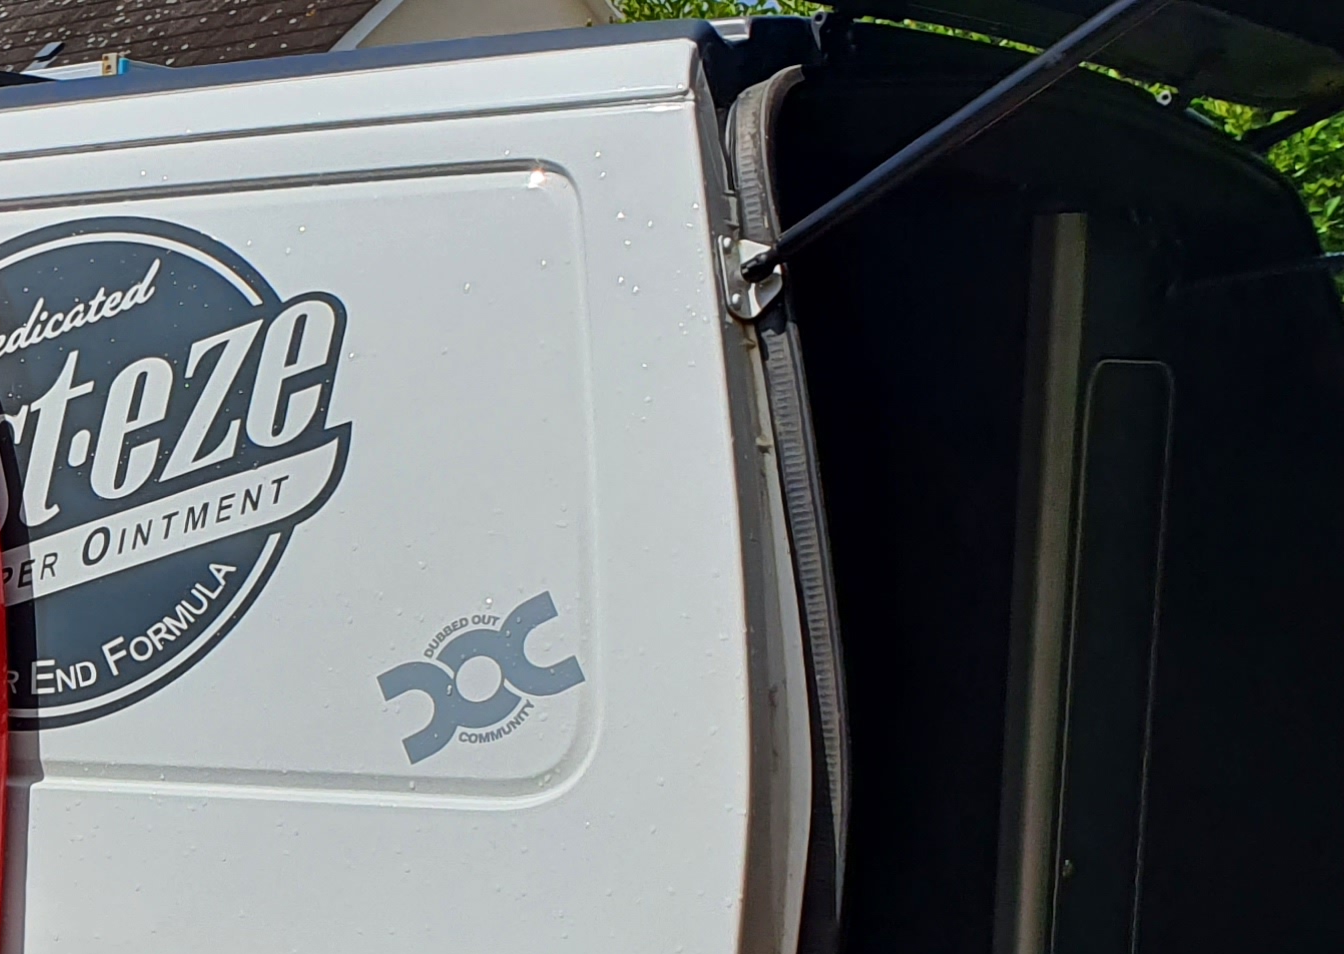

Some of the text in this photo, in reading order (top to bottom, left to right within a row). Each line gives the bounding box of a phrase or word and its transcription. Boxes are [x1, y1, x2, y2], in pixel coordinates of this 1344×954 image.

[2, 552, 58, 588] PER
[424, 614, 501, 659] DUBBED OUT
[458, 699, 535, 744] COMMUNITY
